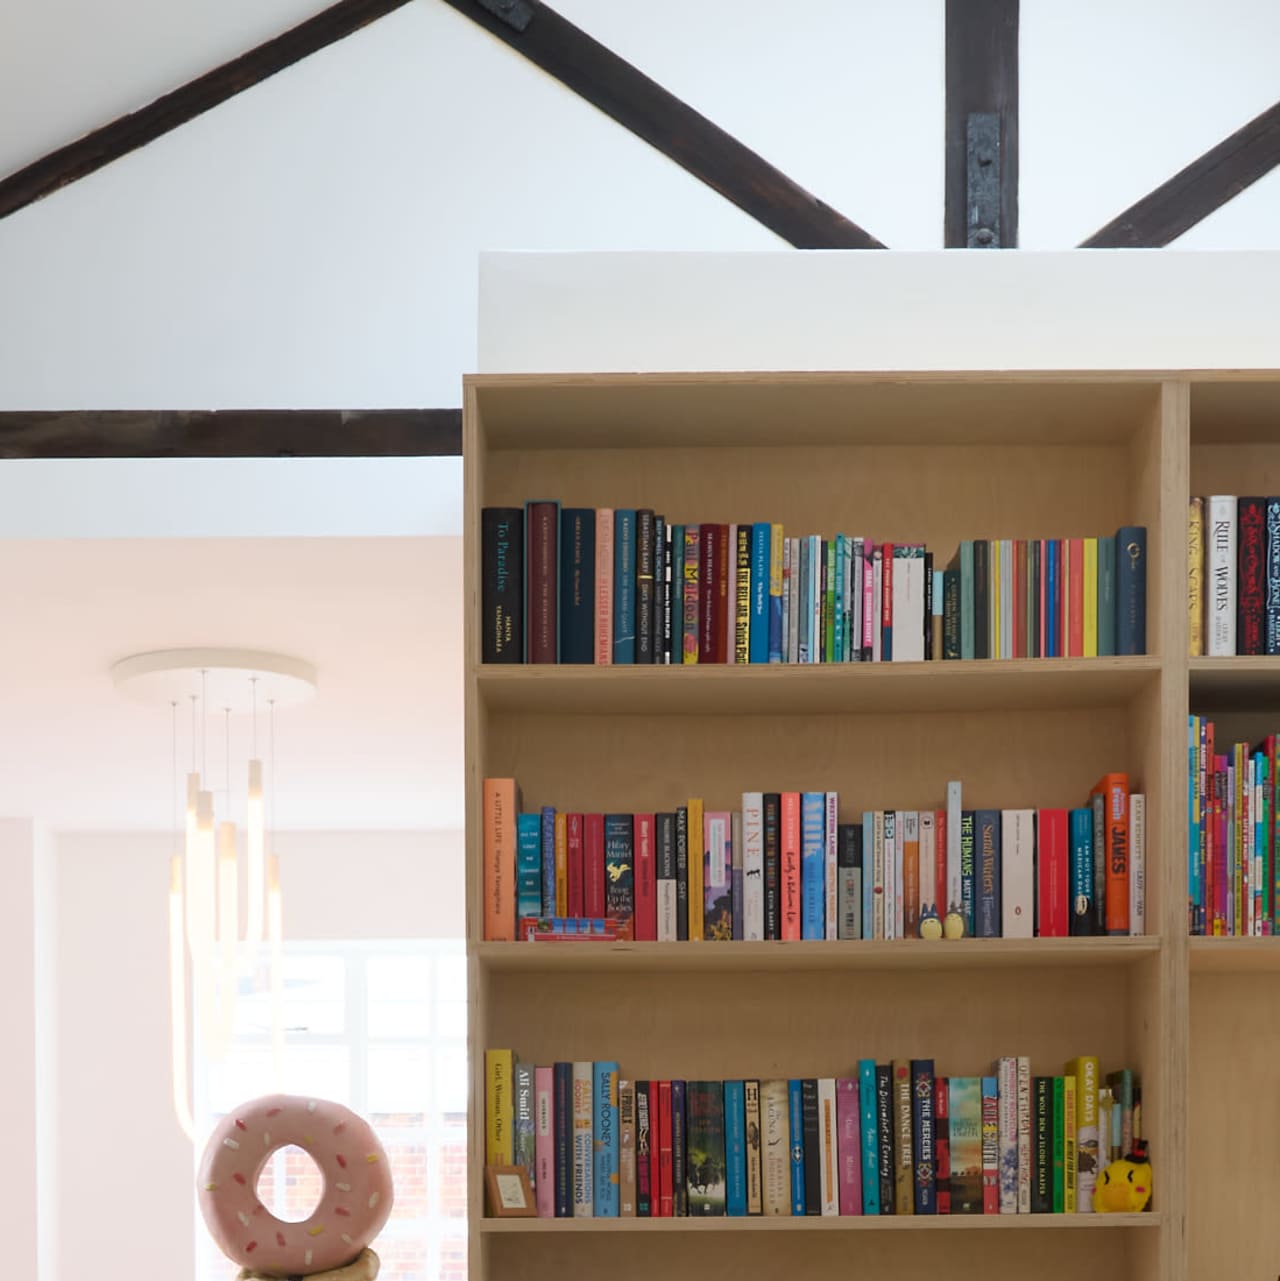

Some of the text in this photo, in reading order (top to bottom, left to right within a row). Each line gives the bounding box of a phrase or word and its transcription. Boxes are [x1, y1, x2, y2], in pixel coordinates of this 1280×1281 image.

[496, 522, 509, 592] To Paradise
[685, 532, 697, 631] Paul Muldoon
[1214, 521, 1229, 611] RULE WOLVES
[677, 810, 686, 900] MAX PORTER SHY
[747, 808, 759, 856] PINE
[961, 816, 972, 876] THE HUMANS
[982, 824, 993, 894] Sarah Waters
[1113, 827, 1126, 874] JAMES
[520, 1070, 529, 1086] Ali
[601, 1072, 611, 1146] SALLY ROONEY
[1085, 1062, 1094, 1090] OKAY
[901, 1083, 910, 1165] THE DANCE TREE
[922, 1099, 930, 1160] THE MERCIES
